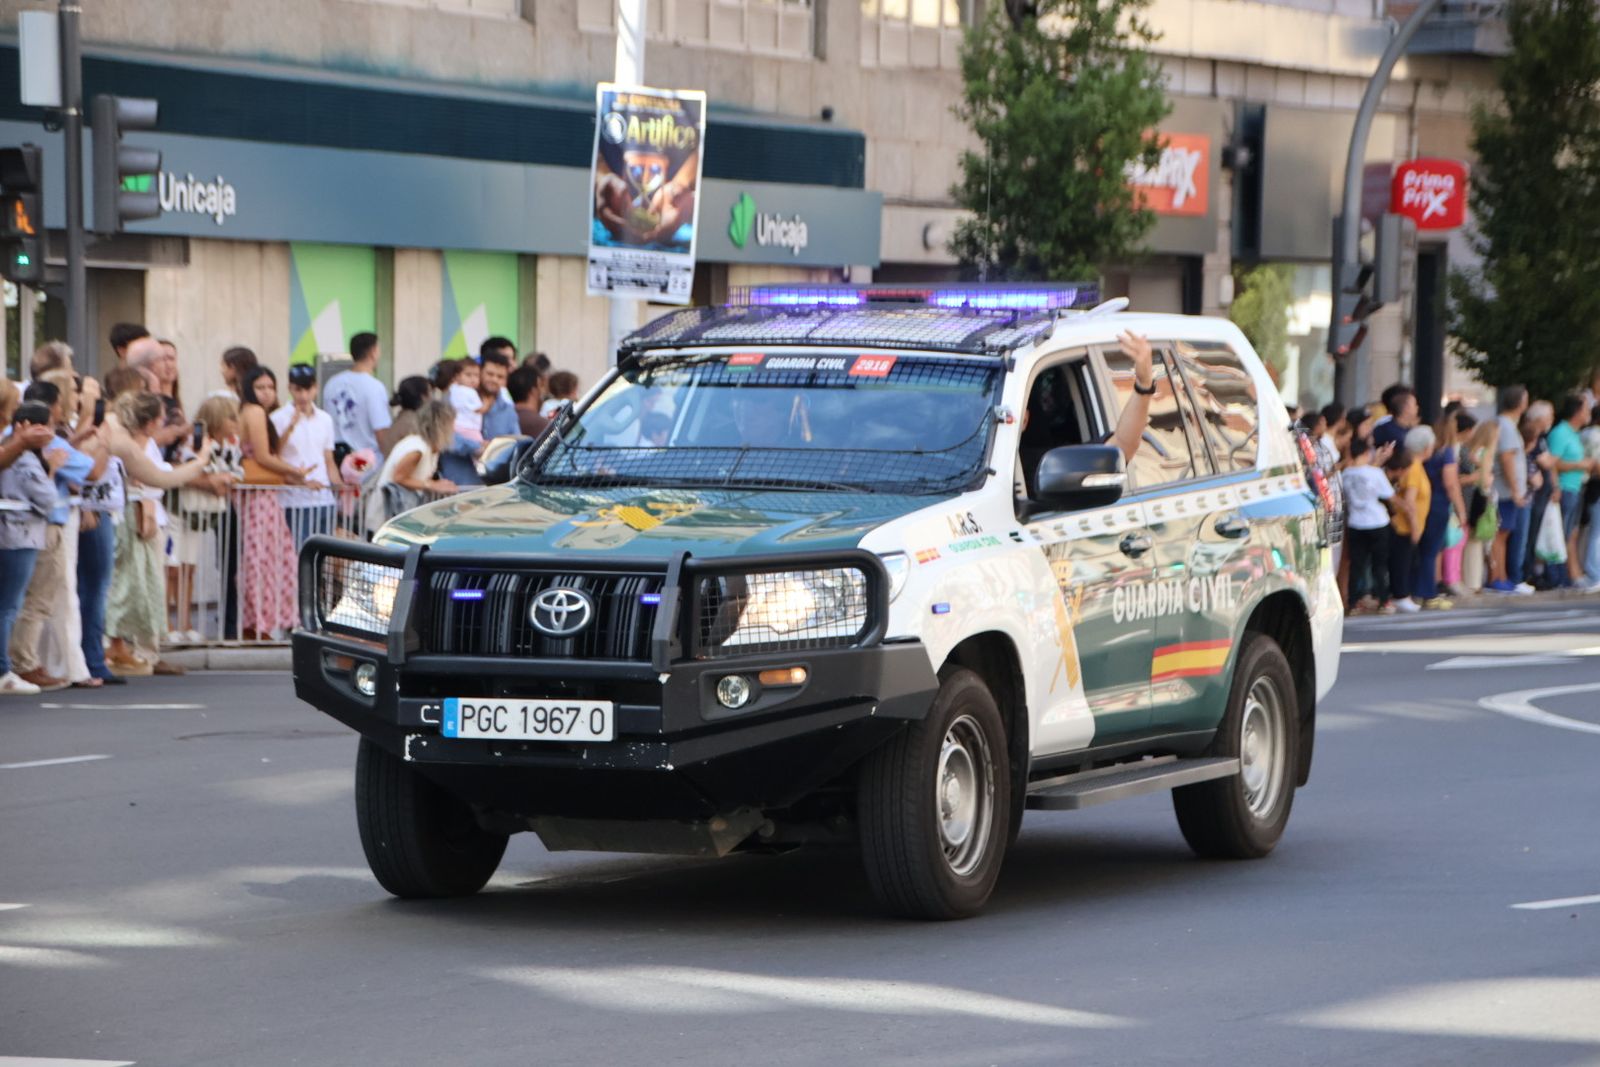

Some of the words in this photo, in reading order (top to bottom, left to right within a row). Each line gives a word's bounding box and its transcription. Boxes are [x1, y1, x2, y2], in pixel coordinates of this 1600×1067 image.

[1403, 169, 1455, 191] Prima
[158, 171, 236, 225] Unicaja
[757, 213, 808, 256] Unicaja
[765, 356, 816, 369] GUARDIA
[816, 358, 847, 370] CIVIL
[1112, 579, 1184, 624] GUARDIA
[1189, 573, 1236, 613] CIVIL
[447, 721, 455, 730] E
[461, 704, 508, 733] PGC
[520, 706, 581, 735] 1967
